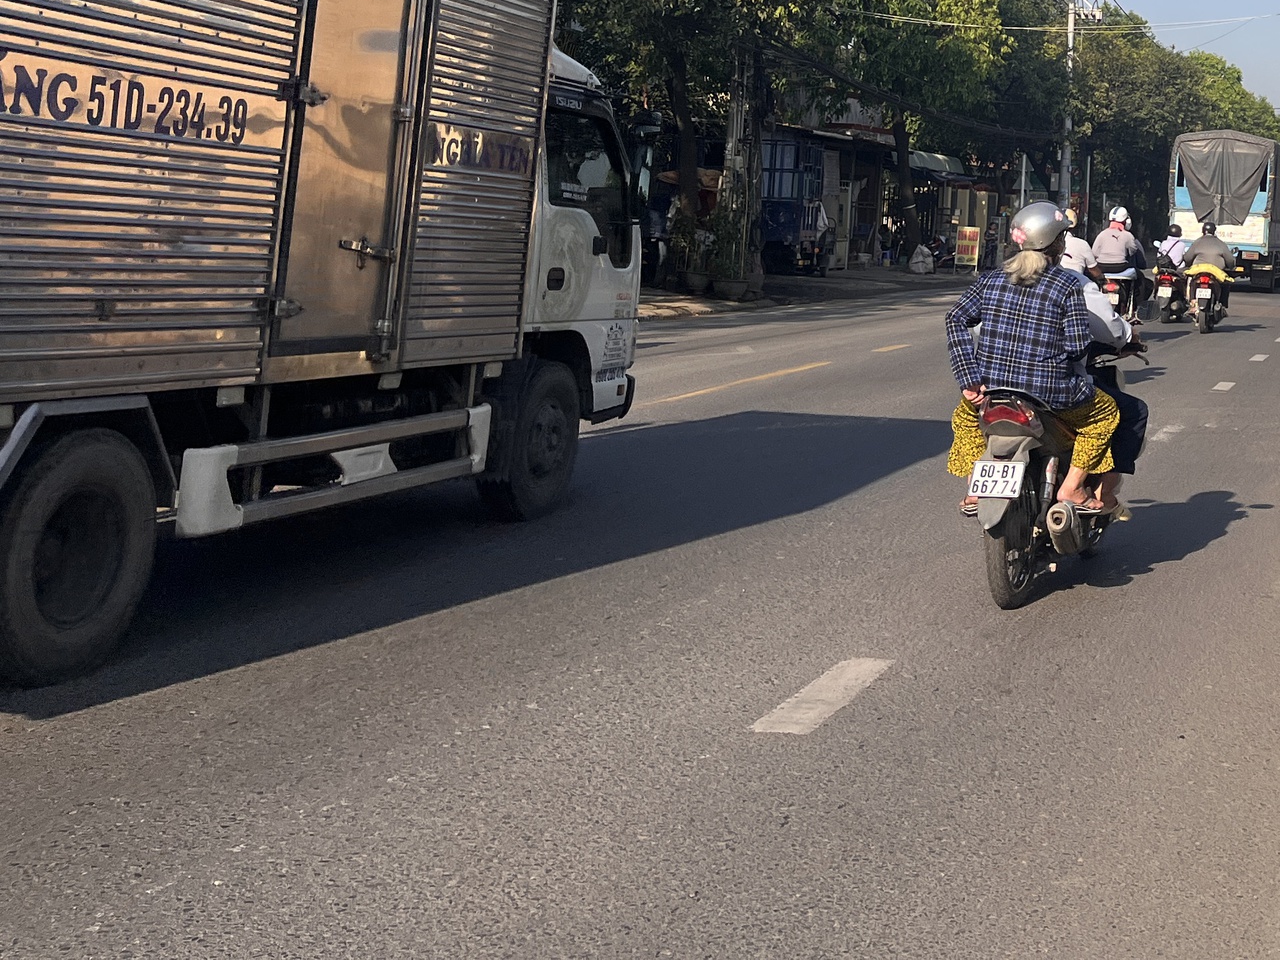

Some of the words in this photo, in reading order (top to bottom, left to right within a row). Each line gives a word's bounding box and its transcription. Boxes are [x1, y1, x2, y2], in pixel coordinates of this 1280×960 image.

[0, 62, 78, 121] NG
[87, 75, 248, 146] 51D-234.39
[556, 96, 582, 110] ISUZU
[980, 464, 1016, 478] 60-B1
[971, 480, 1017, 494] 667.74
